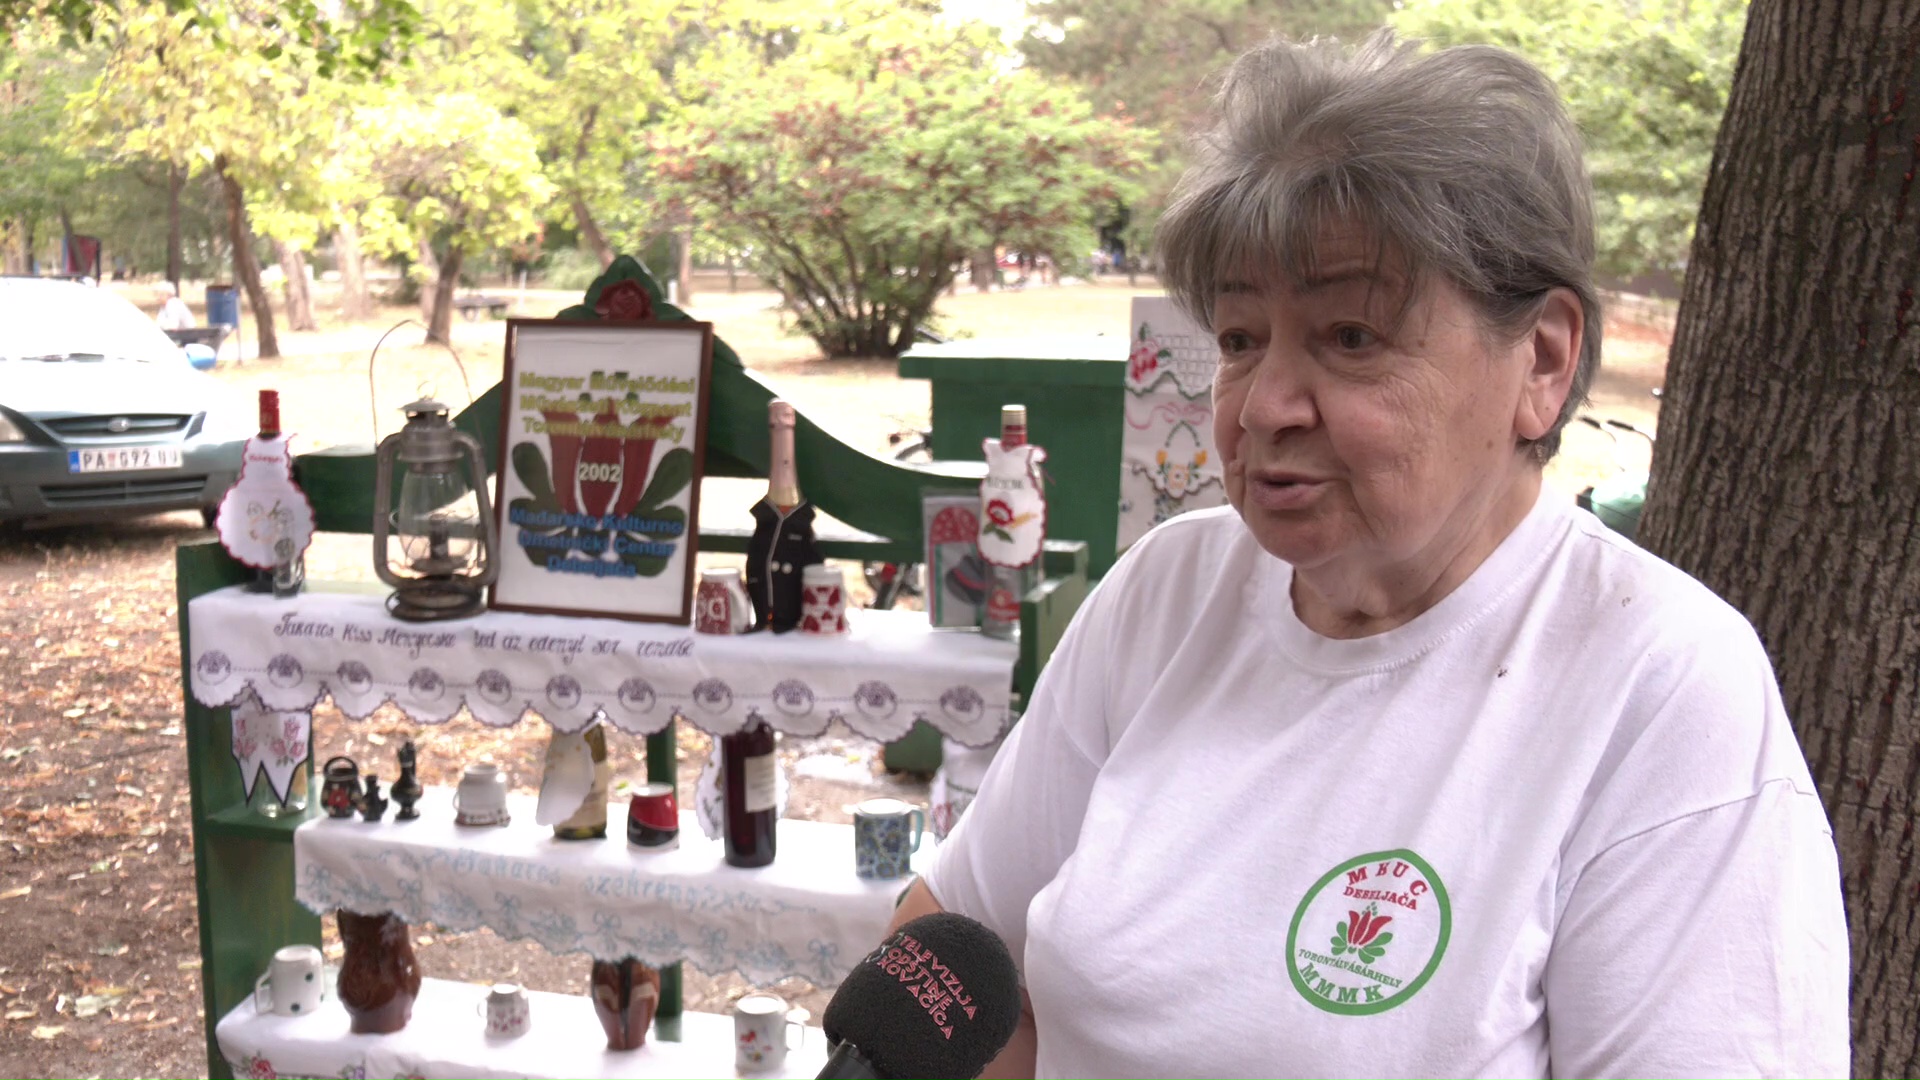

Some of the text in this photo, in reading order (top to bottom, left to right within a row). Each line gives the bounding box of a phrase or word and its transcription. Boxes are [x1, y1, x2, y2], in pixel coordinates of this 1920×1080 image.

[520, 372, 584, 392] Magyar
[579, 462, 622, 482] 2002
[1343, 886, 1417, 910] DEBELJAČA
[900, 935, 977, 1020] TELEVIZIJA
[1300, 962, 1384, 1003] MMMK
